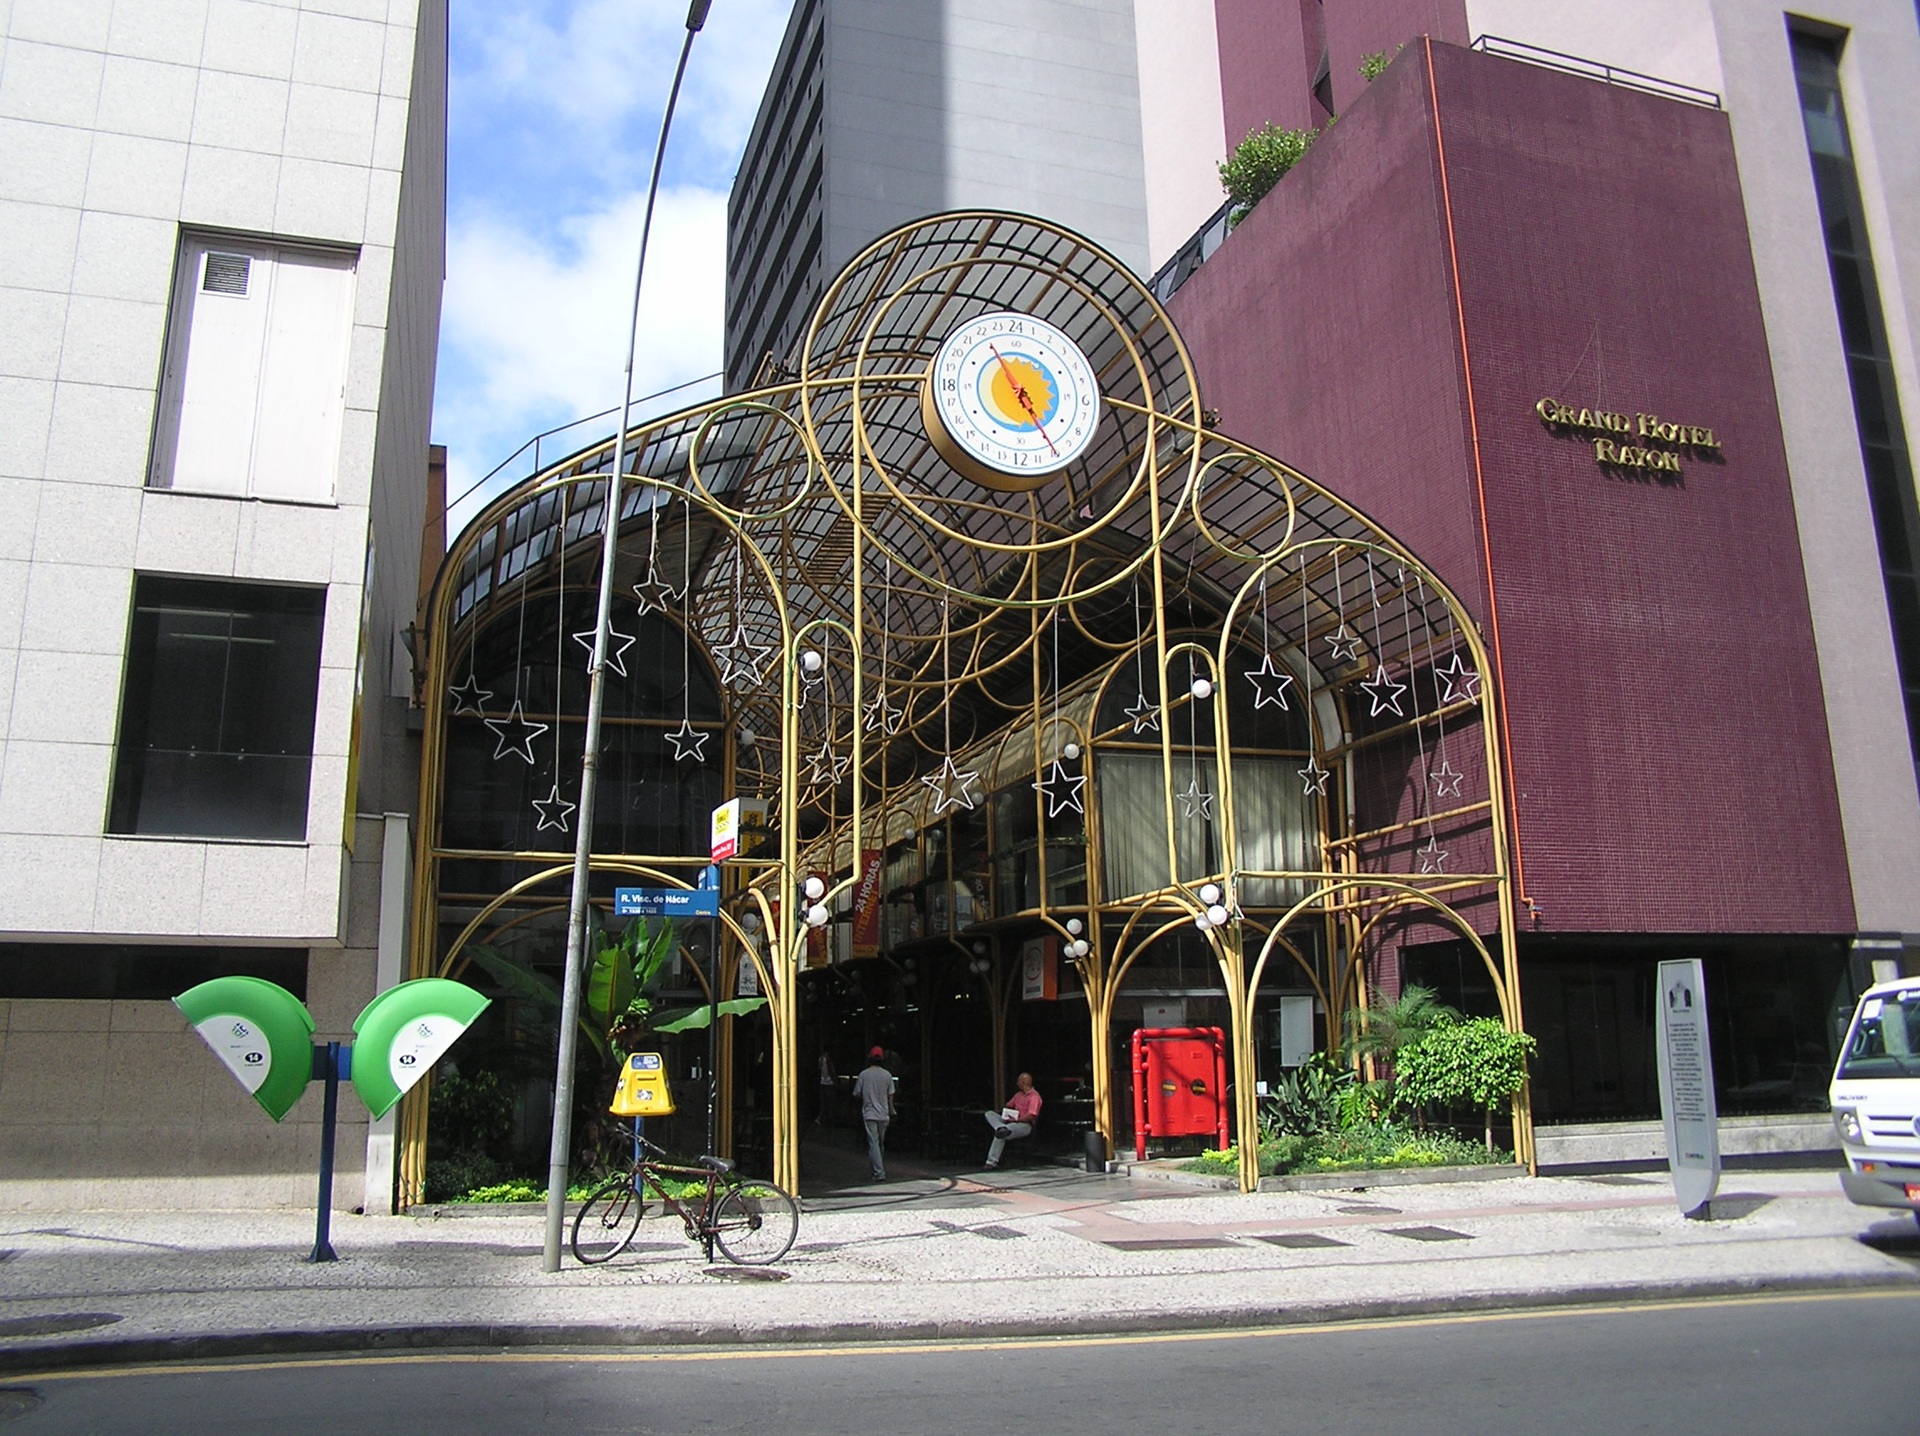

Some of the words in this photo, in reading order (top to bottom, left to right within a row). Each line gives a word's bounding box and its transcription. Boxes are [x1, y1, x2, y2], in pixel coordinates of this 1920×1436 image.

[976, 326, 987, 336] 22
[992, 322, 1003, 331] 23
[1008, 320, 1023, 333] 24
[963, 335, 972, 345] 21
[951, 348, 963, 358] 20
[946, 362, 956, 372] 19
[942, 378, 956, 392] 18
[947, 397, 956, 407] 17
[1081, 394, 1090, 406] 6
[955, 415, 964, 425] 16
[1535, 397, 1630, 432] GRAND
[1636, 412, 1721, 448] HOTEL
[966, 430, 976, 440] 15
[1075, 427, 1081, 436] 8
[981, 442, 990, 452] 14
[998, 451, 1007, 461] 13
[1034, 455, 1042, 464] 11
[1593, 437, 1681, 472] RAYON
[1014, 453, 1028, 467] 12
[855, 898, 866, 913] 24
[861, 860, 880, 898] HORAS
[621, 894, 630, 902] R.
[632, 894, 652, 903] Visc.
[653, 895, 664, 903] de
[665, 894, 689, 904] Nácar
[249, 1053, 259, 1062] 14
[402, 1055, 412, 1064] 14
